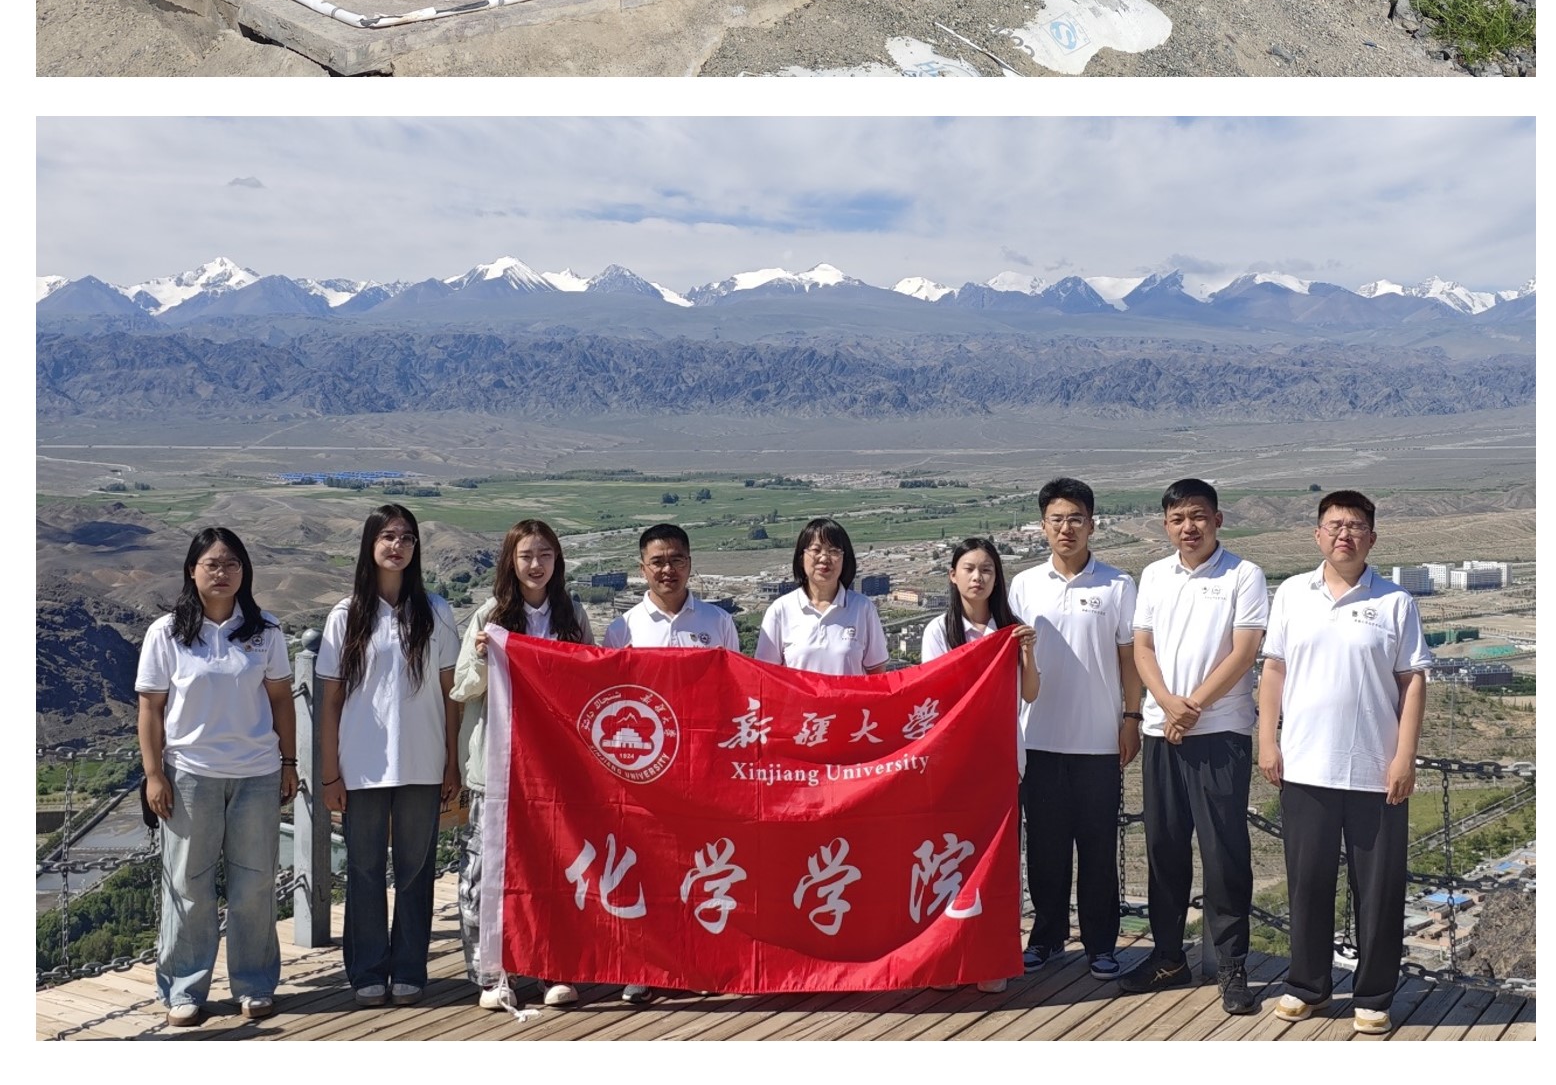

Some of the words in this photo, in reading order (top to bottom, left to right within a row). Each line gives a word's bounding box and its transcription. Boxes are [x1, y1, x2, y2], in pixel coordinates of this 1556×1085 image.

[624, 752, 671, 781] UNIVERSITY
[731, 761, 819, 786] Xinjiang
[825, 753, 930, 781] University
[564, 832, 983, 936] 化学学院
